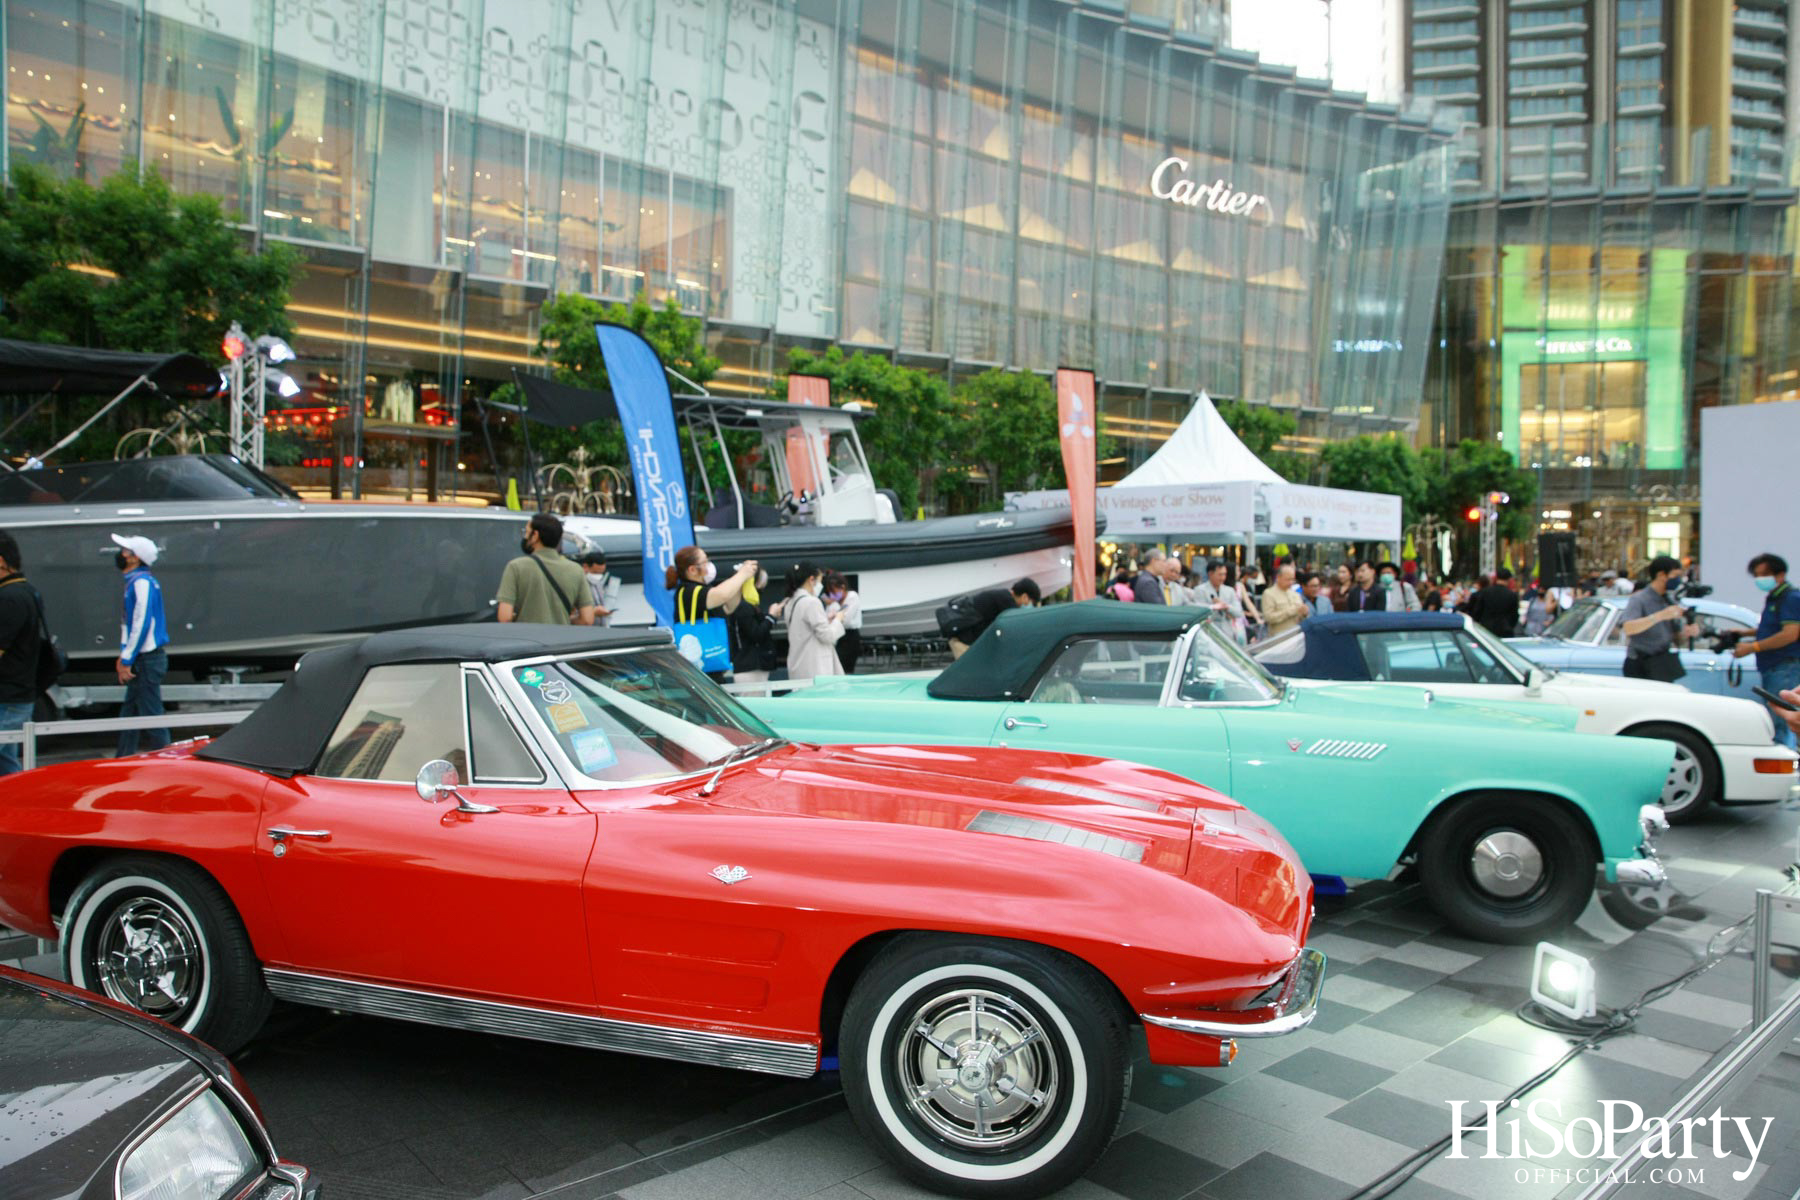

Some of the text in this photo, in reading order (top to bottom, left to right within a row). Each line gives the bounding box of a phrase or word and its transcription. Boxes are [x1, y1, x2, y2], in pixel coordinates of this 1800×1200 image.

[1150, 156, 1266, 217] Cartier
[1112, 494, 1157, 512] Vintage
[1161, 493, 1184, 508] Car
[1187, 490, 1225, 507] Show
